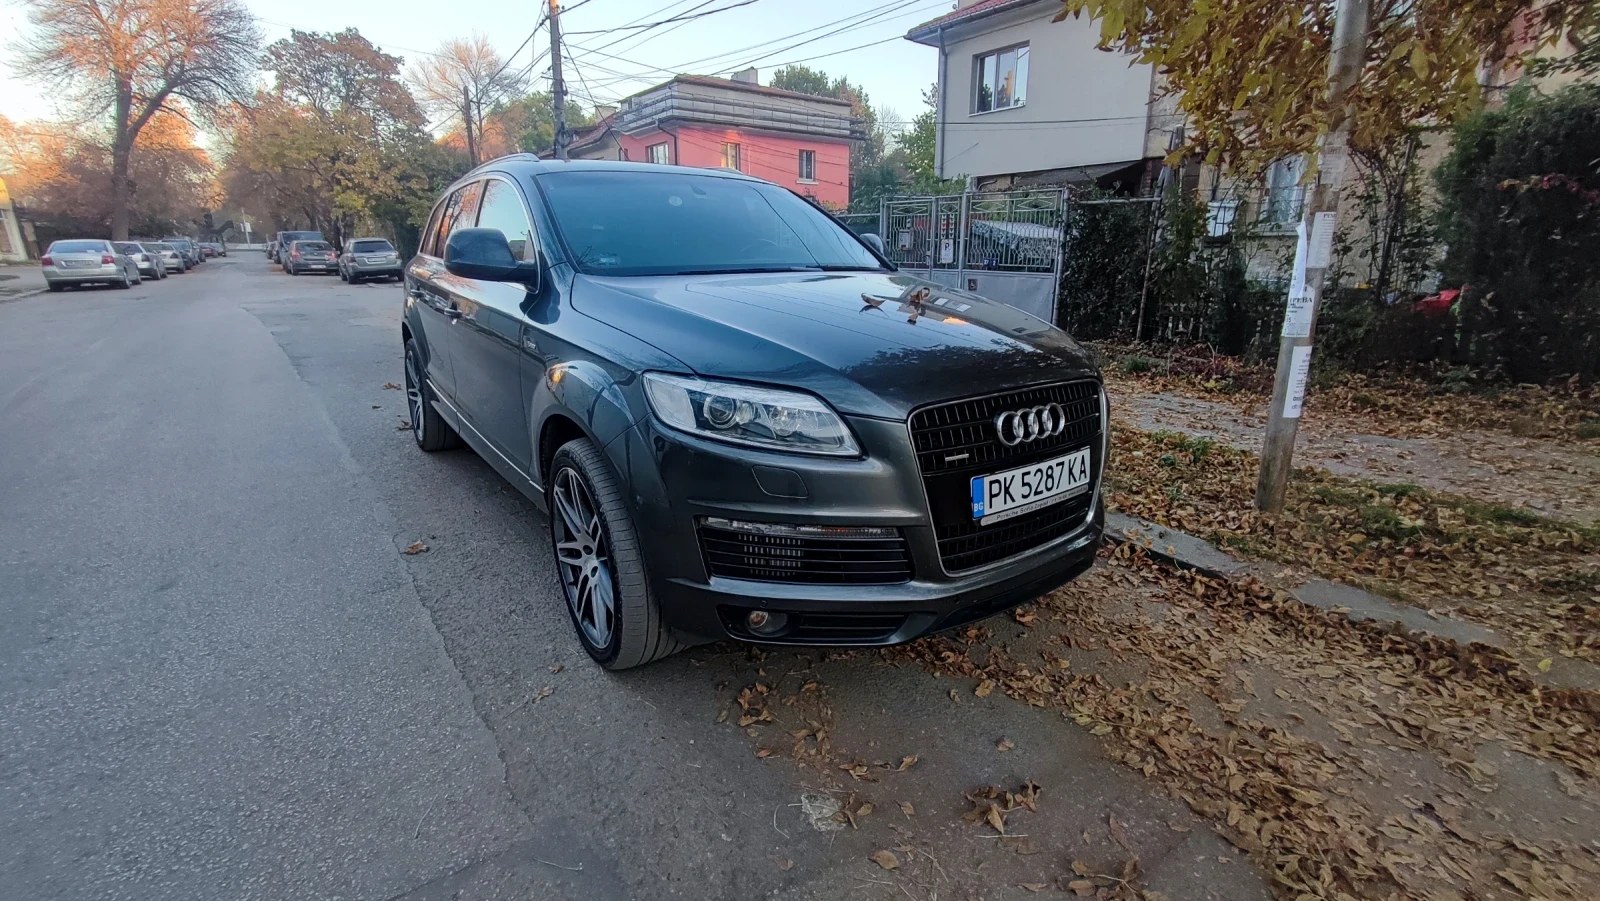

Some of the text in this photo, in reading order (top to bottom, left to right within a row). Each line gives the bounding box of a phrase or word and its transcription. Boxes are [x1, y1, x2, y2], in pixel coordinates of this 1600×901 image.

[974, 502, 984, 512] BG
[988, 475, 1016, 509] PK
[1021, 461, 1065, 500] 5287
[1068, 454, 1087, 486] KA
[996, 509, 1019, 521] Porsche
[1020, 505, 1034, 514] Sofia
